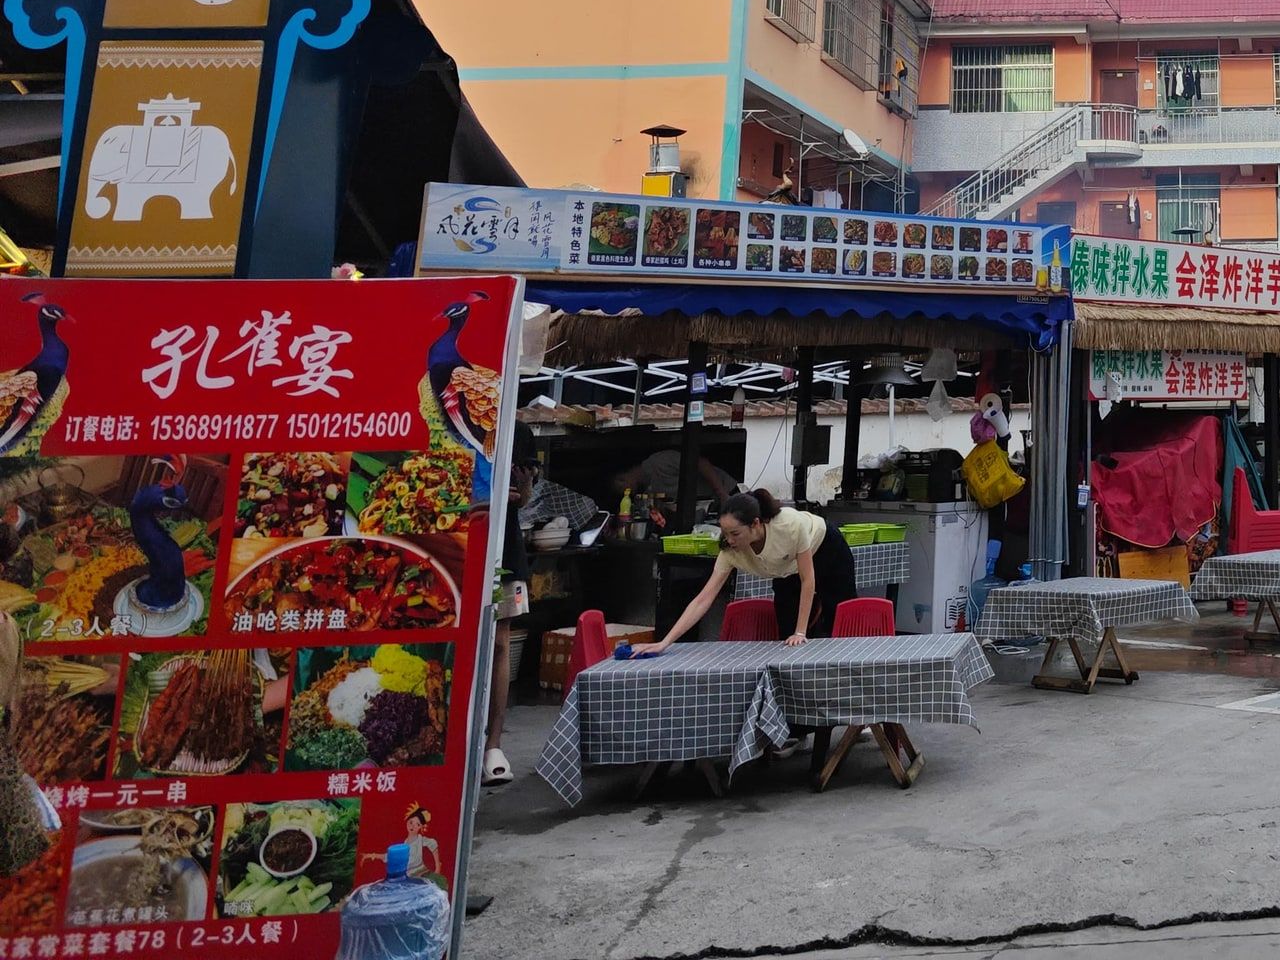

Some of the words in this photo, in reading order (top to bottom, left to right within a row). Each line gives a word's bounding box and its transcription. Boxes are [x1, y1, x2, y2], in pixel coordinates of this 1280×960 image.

[569, 200, 585, 264] 本地特色菜
[1070, 241, 1169, 297] 傣味拌水果
[142, 310, 354, 399] 孔雀宴
[1165, 361, 1244, 395] 会泽炸洋芋
[150, 413, 279, 442] 15368911877
[287, 410, 412, 439] 15012154600
[233, 608, 348, 632] 油呛类拼盘
[45, 780, 188, 811] 烧烤一元一串
[327, 770, 397, 795] 糯米饭
